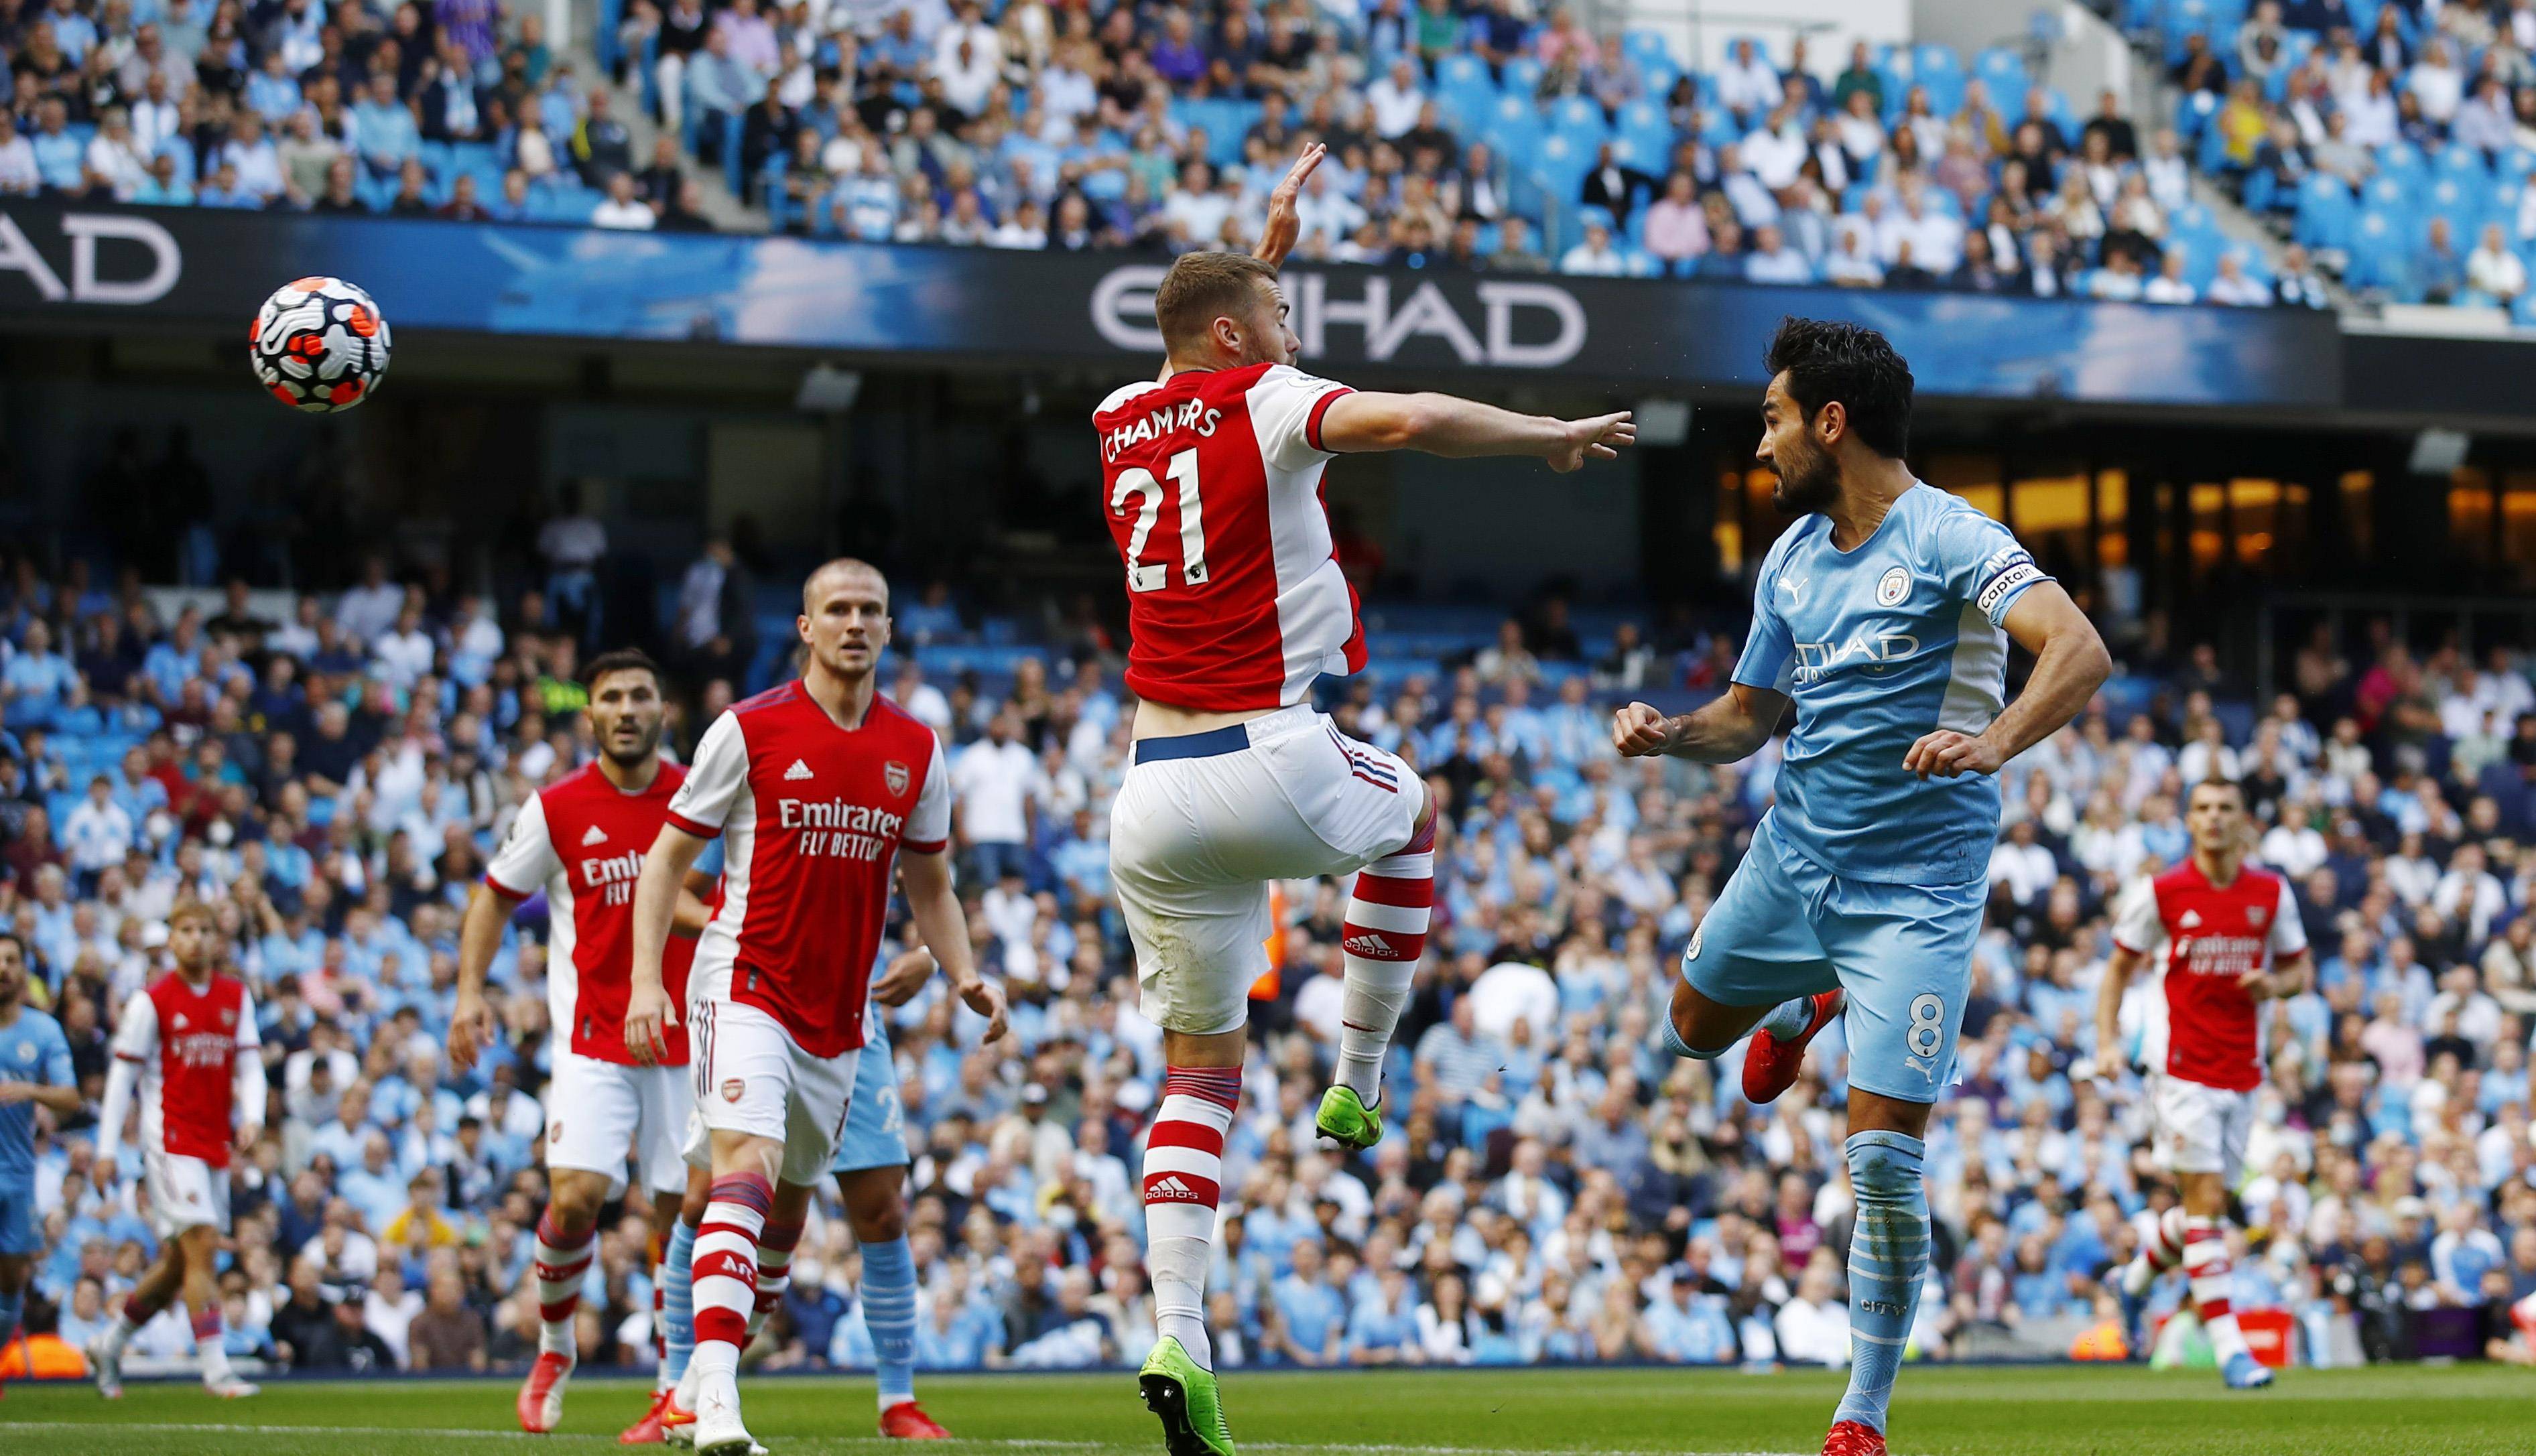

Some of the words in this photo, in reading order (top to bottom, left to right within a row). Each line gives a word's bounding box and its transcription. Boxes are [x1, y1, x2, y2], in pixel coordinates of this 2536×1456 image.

[1090, 265, 1588, 368] EIHAD
[1110, 447, 1209, 593] 21
[1794, 633, 1920, 668] TIHAD
[778, 797, 903, 840] Emirates
[799, 831, 829, 857] FLY
[830, 832, 885, 862] BETTER
[1344, 939, 1399, 957] adidas
[1906, 992, 1946, 1059] 8
[1145, 1189, 1199, 1200] adidas
[1860, 1298, 1908, 1317] CITY
